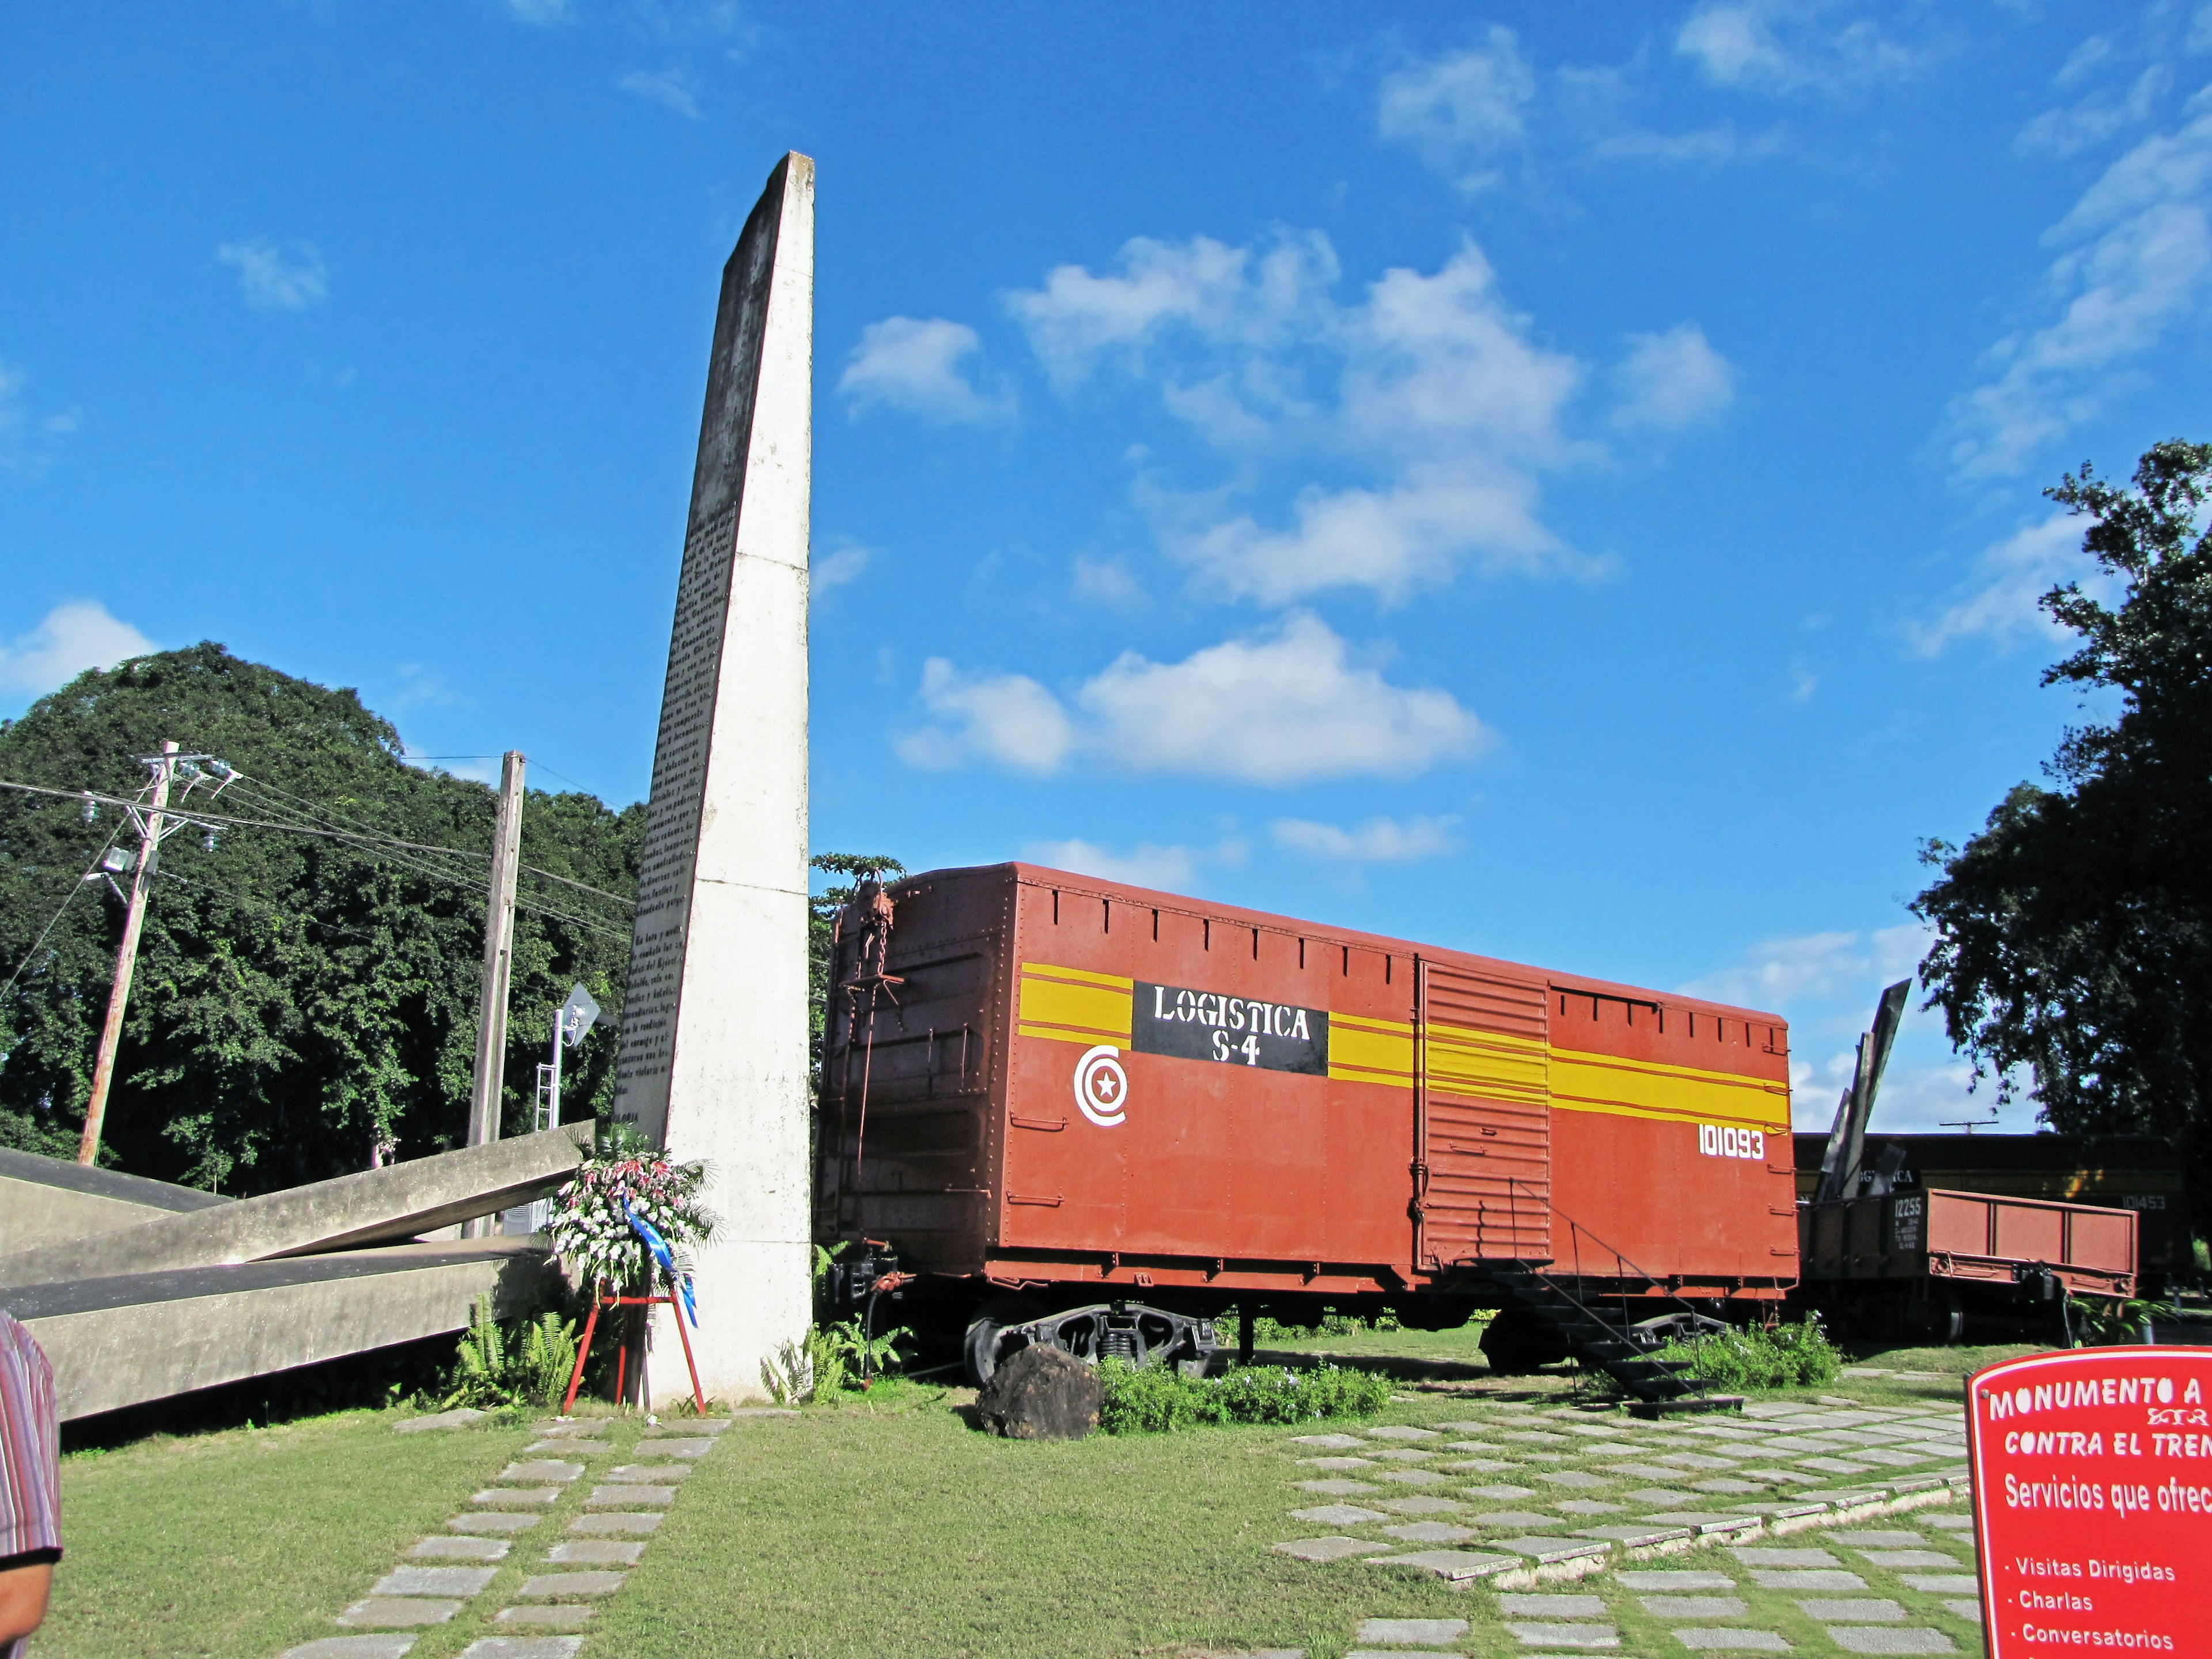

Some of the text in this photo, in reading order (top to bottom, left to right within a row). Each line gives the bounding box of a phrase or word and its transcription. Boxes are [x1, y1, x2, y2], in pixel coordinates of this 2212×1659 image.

[1154, 986, 1310, 1040] LOGISTICA
[1212, 1029, 1260, 1066] S-4
[1699, 1124, 1764, 1160] 101093
[1895, 1197, 1922, 1217] 12255
[2122, 1195, 2166, 1210] 101453
[1989, 1377, 2201, 1421] MONUMENTO A
[2005, 1431, 2212, 1458] CONTRA EL TREN
[2005, 1473, 2212, 1518] Servicios que ofrec
[2015, 1557, 2176, 1584] Visitas Dirigidas
[2019, 1590, 2093, 1611] Charlas
[2022, 1623, 2174, 1650] Conversatorios
